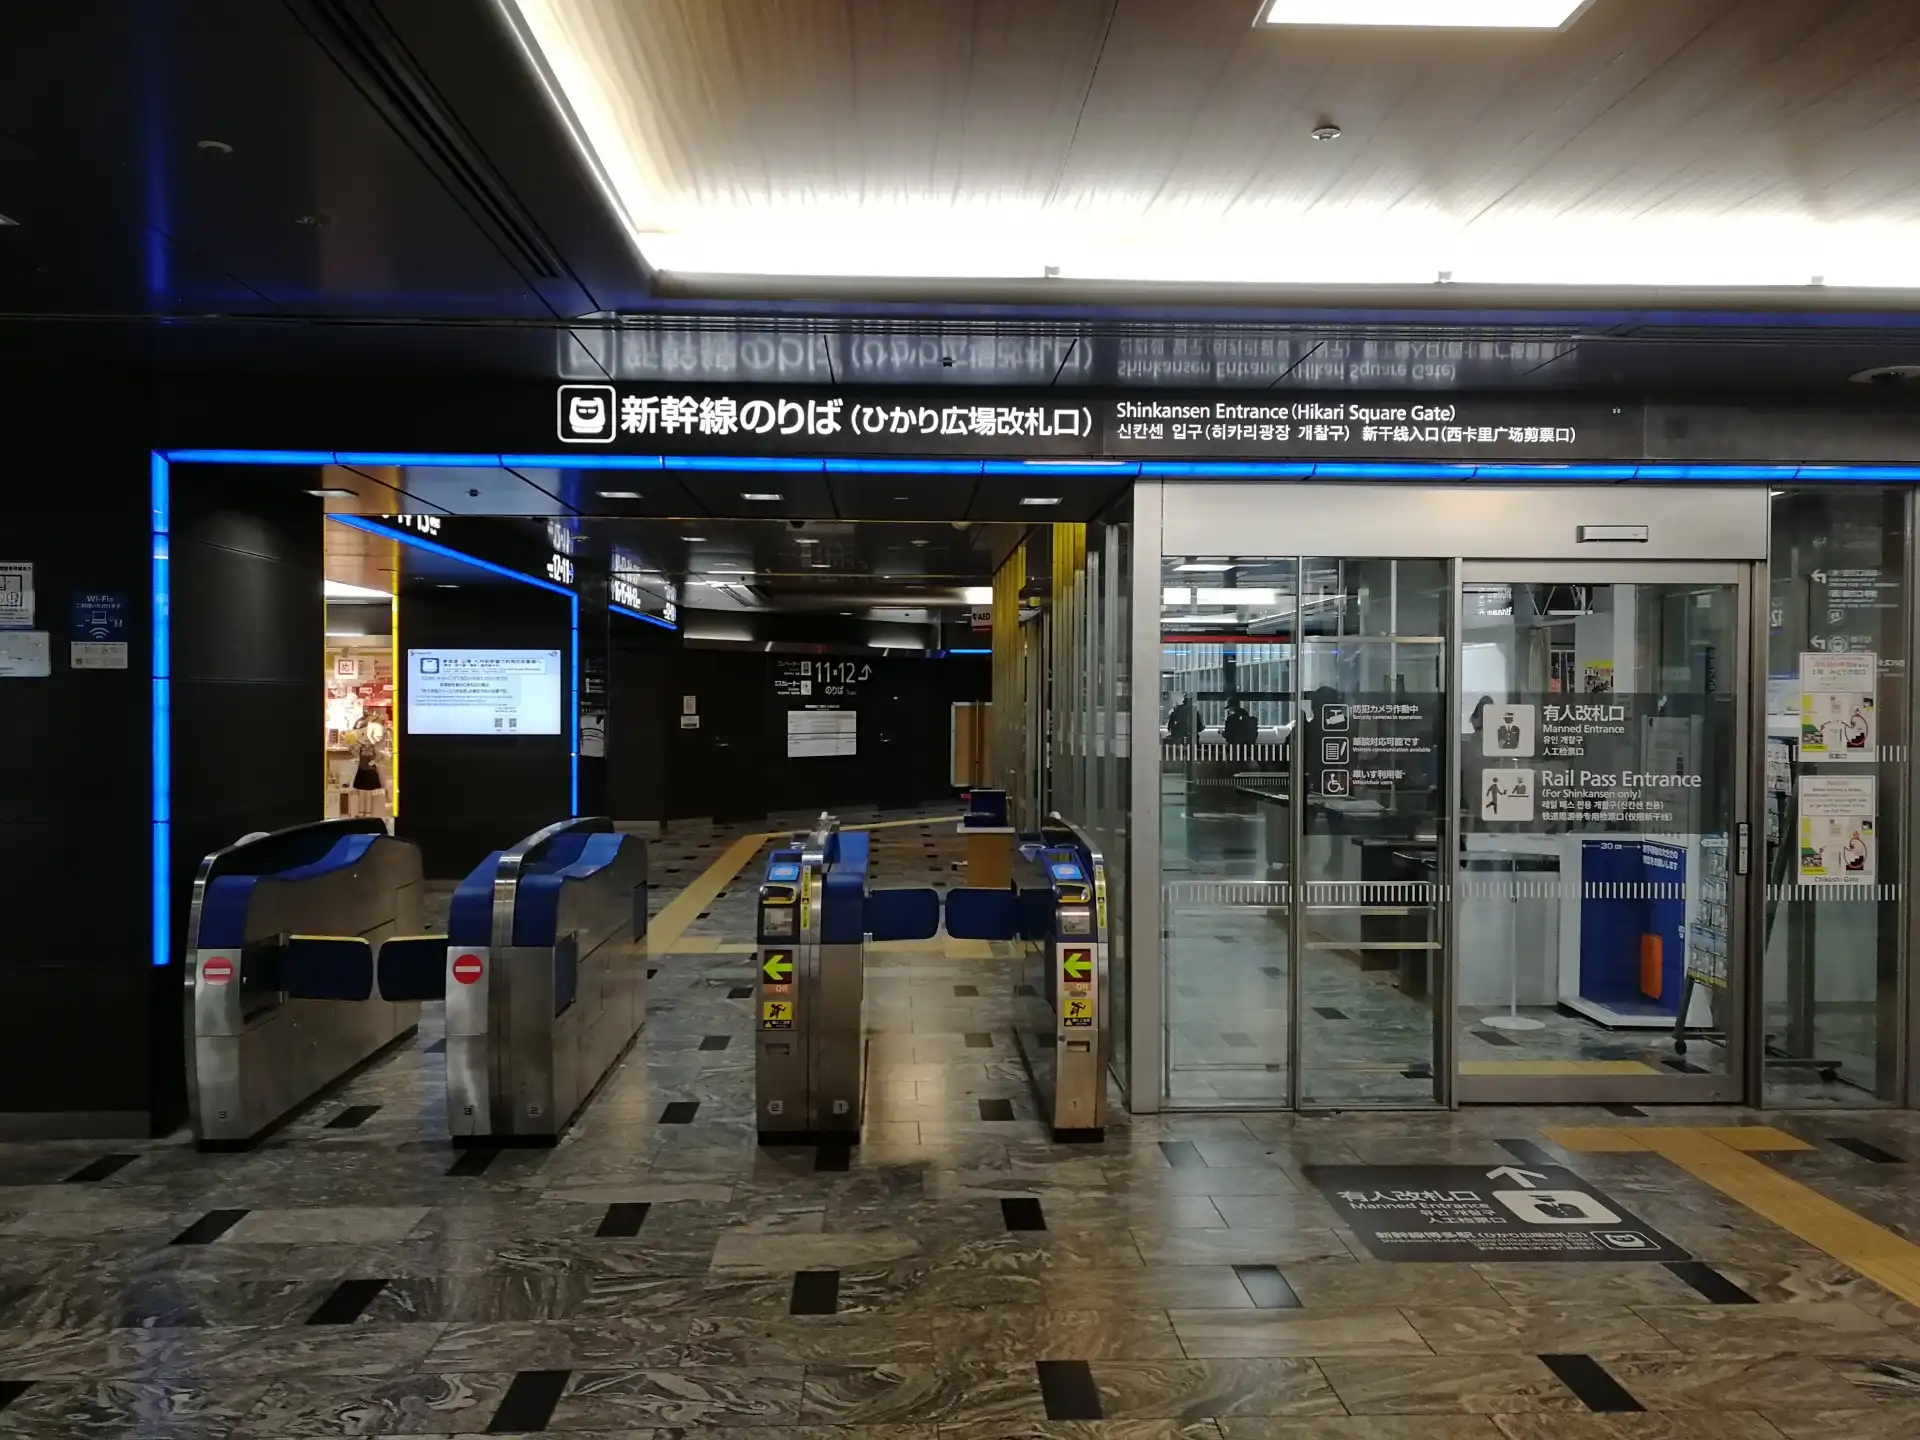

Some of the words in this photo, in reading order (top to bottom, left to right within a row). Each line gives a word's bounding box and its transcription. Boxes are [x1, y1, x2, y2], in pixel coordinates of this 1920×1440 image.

[621, 396, 843, 436] 新幹線のりば
[851, 404, 1093, 438] (ひかり広場改札口)
[1117, 402, 1211, 420] Shinkansen
[1215, 403, 1289, 420] Entrance
[1291, 404, 1345, 422] (Hikari
[1349, 404, 1406, 424] Square
[1411, 404, 1456, 423] Gate)
[1117, 423, 1164, 441] 신칸센
[1171, 424, 1291, 443] 입구(히카리광장
[1298, 424, 1351, 443] 개찰구)
[977, 611, 991, 621] AED
[824, 685, 844, 695] のりば
[1353, 704, 1419, 714] 防犯カメラ作動中
[1543, 704, 1624, 722] 有人改札口
[1543, 724, 1582, 733] Manned
[1584, 724, 1625, 733] Entrance
[1543, 735, 1558, 744] 유인
[1542, 747, 1584, 756] 人工检票口
[1542, 769, 1574, 787] Rail
[1580, 770, 1617, 787] Pass
[1622, 770, 1702, 788] Entrance
[1542, 789, 1561, 798] (For
[1562, 789, 1615, 798] Shinkansen
[1617, 789, 1641, 799] only)
[1600, 842, 1614, 850] 30
[1337, 1190, 1482, 1202] 有人改札口
[1350, 1202, 1418, 1210] Manned
[1420, 1202, 1491, 1210] Entrance
